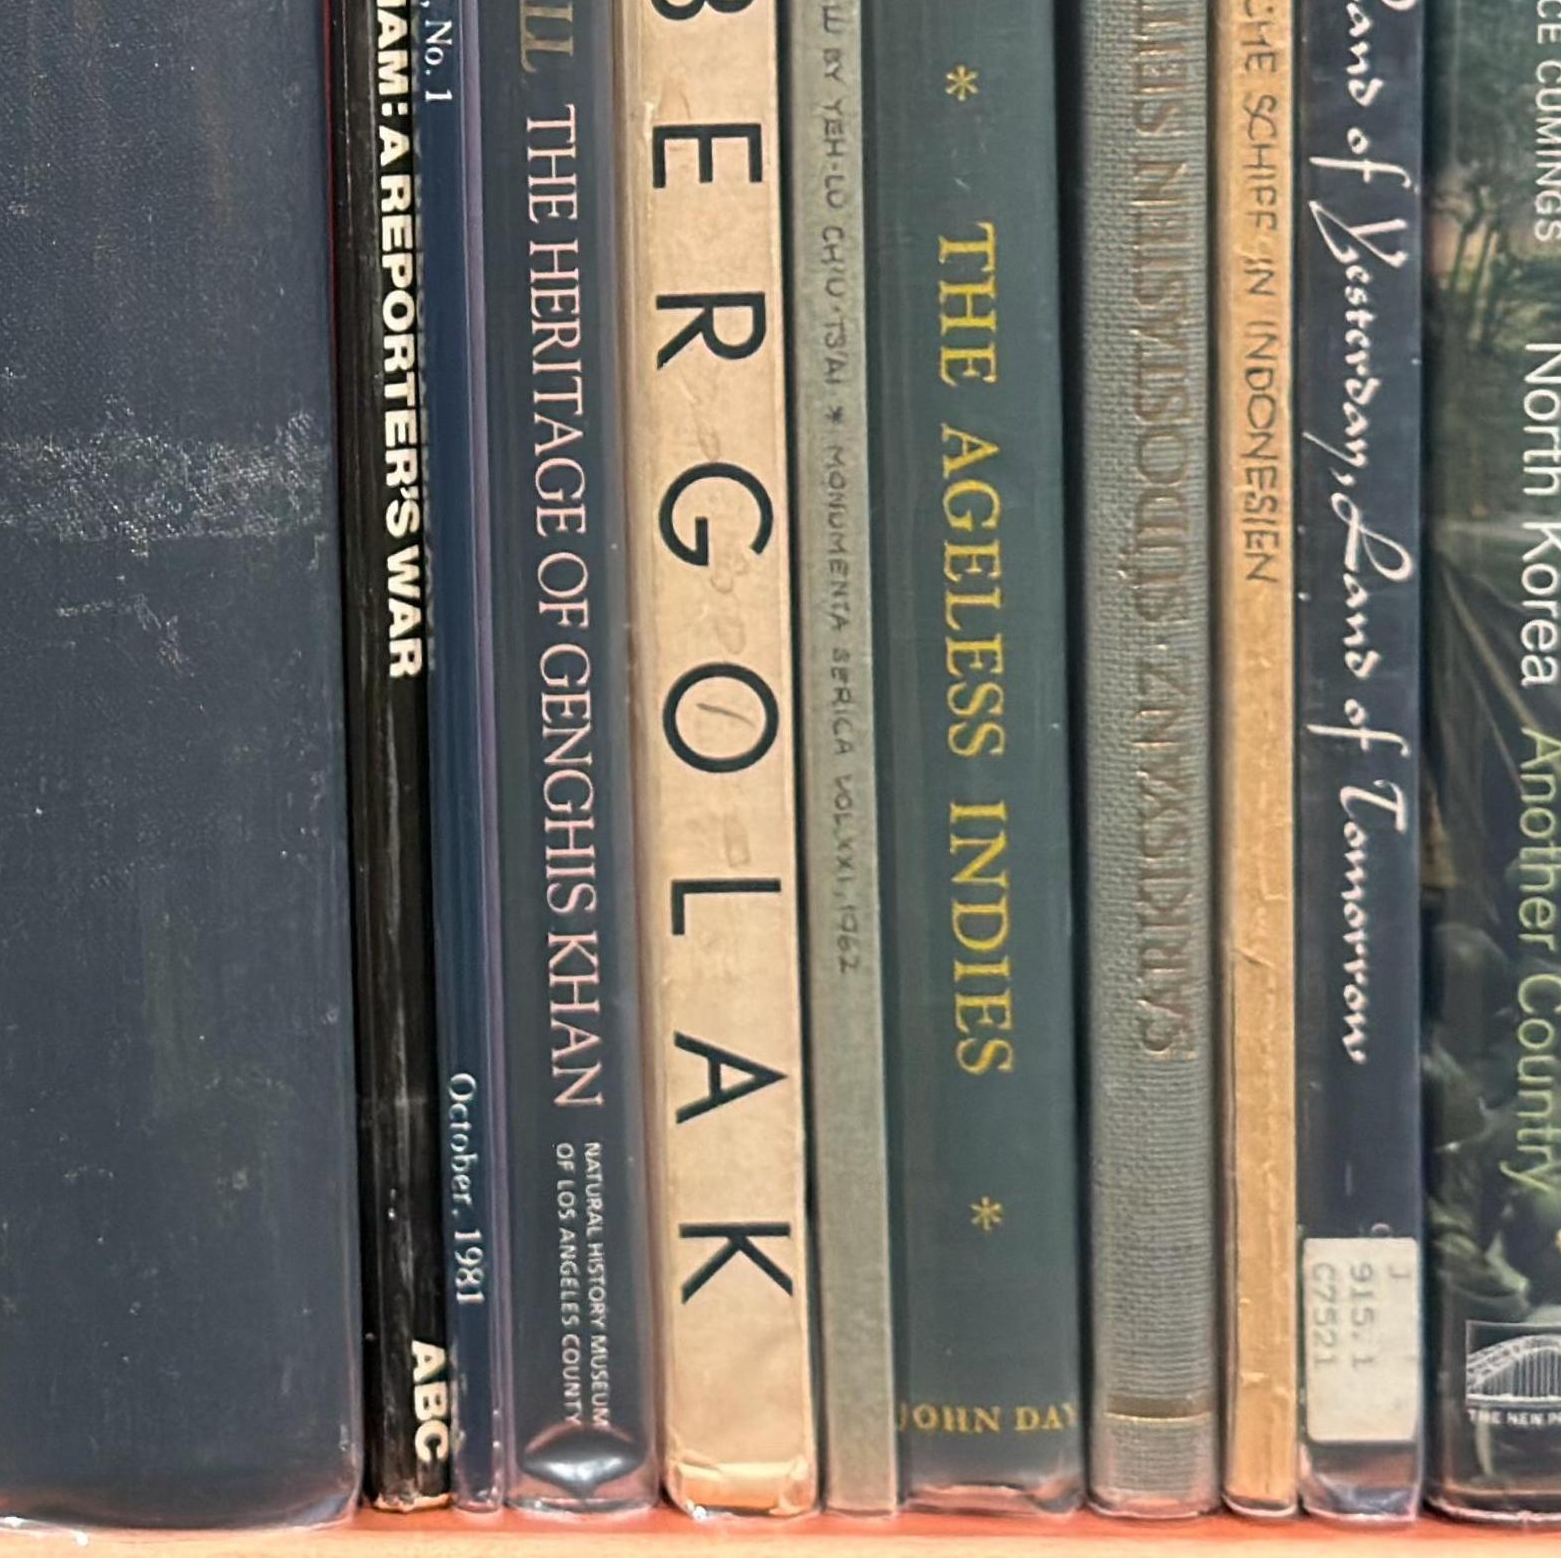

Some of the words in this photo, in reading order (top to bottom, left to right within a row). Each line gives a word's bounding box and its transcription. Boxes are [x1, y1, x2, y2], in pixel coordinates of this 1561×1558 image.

[423, 20, 453, 77] No.
[424, 89, 453, 103] 1
[378, 125, 410, 166] A
[525, 103, 579, 224] THE
[1241, 93, 1280, 227] SCHIFF
[938, 221, 998, 387] THE
[1241, 253, 1280, 296] IN
[379, 174, 420, 539] REPORTER'S
[529, 240, 586, 538] HERITAGE
[1241, 320, 1281, 584] INDONESIEN
[387, 545, 423, 678] WAR
[536, 552, 590, 628] OF
[941, 422, 1006, 758] AGELESS
[539, 643, 599, 914] GENGHIS
[948, 800, 1015, 1076] INDIES
[546, 931, 604, 1109] KHAN
[583, 1140, 605, 1238] NATURAL
[586, 1241, 608, 1330] HISTORY
[1351, 1262, 1376, 1370] 915.1
[411, 1340, 449, 1464] ABC
[589, 1334, 611, 1426] MUSEUM
[897, 1400, 1002, 1434] JOHN
[1467, 1408, 1504, 1425] THE
[1508, 1410, 1542, 1426] NEW
